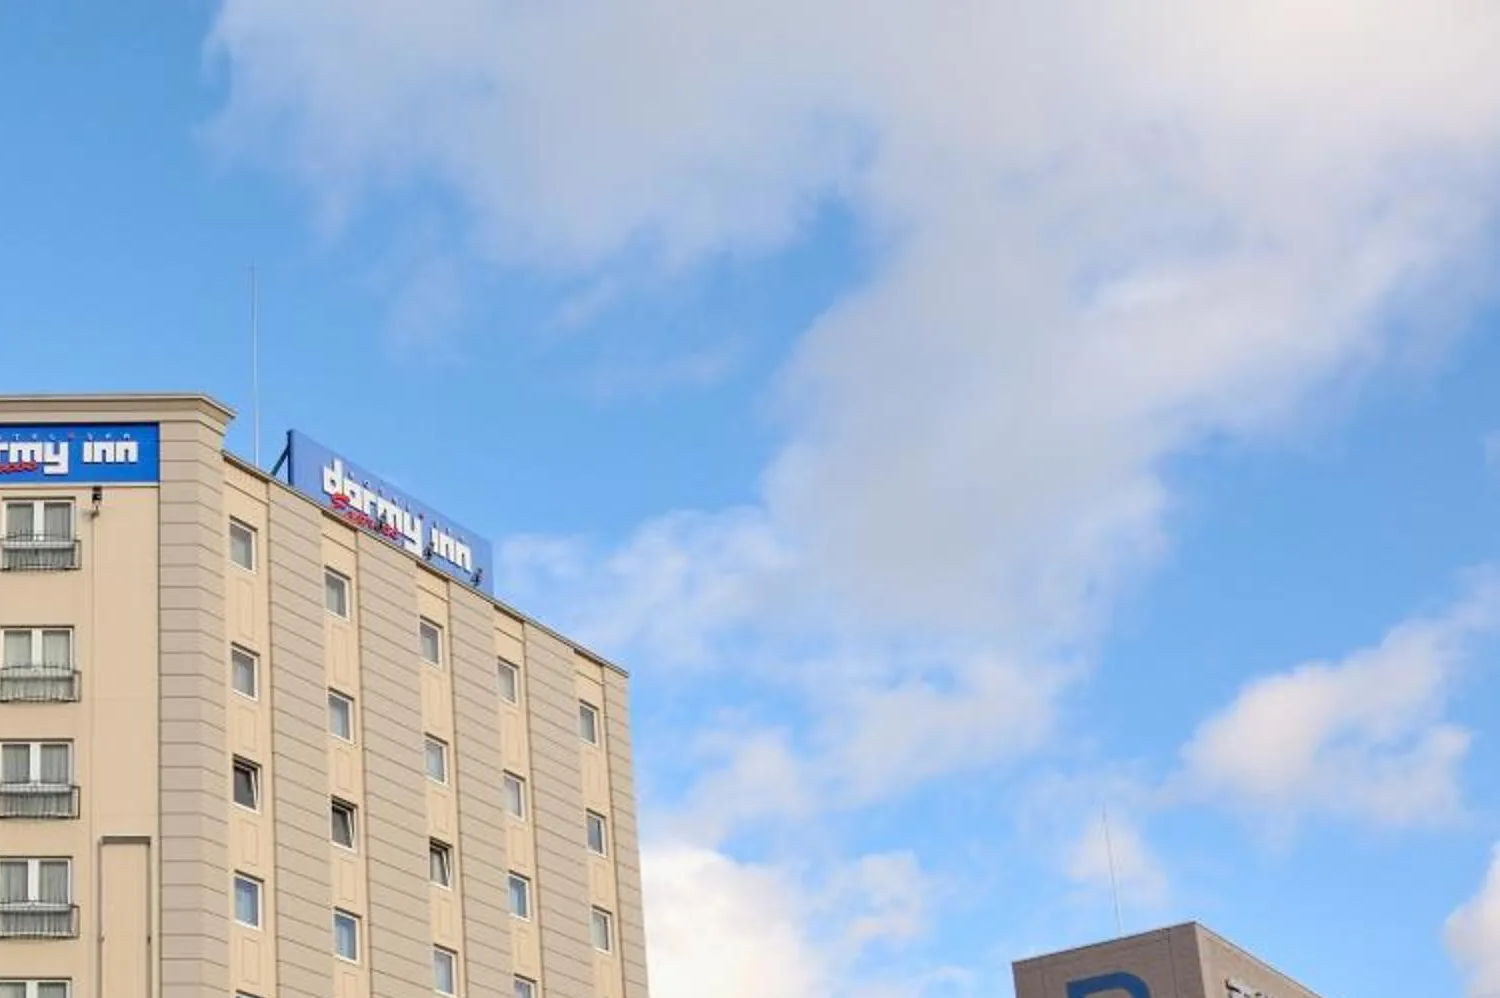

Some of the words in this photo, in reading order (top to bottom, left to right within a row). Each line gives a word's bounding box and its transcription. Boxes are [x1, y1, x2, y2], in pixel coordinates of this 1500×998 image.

[83, 441, 138, 463] inn
[323, 458, 422, 558] dormy
[431, 527, 472, 572] inn
